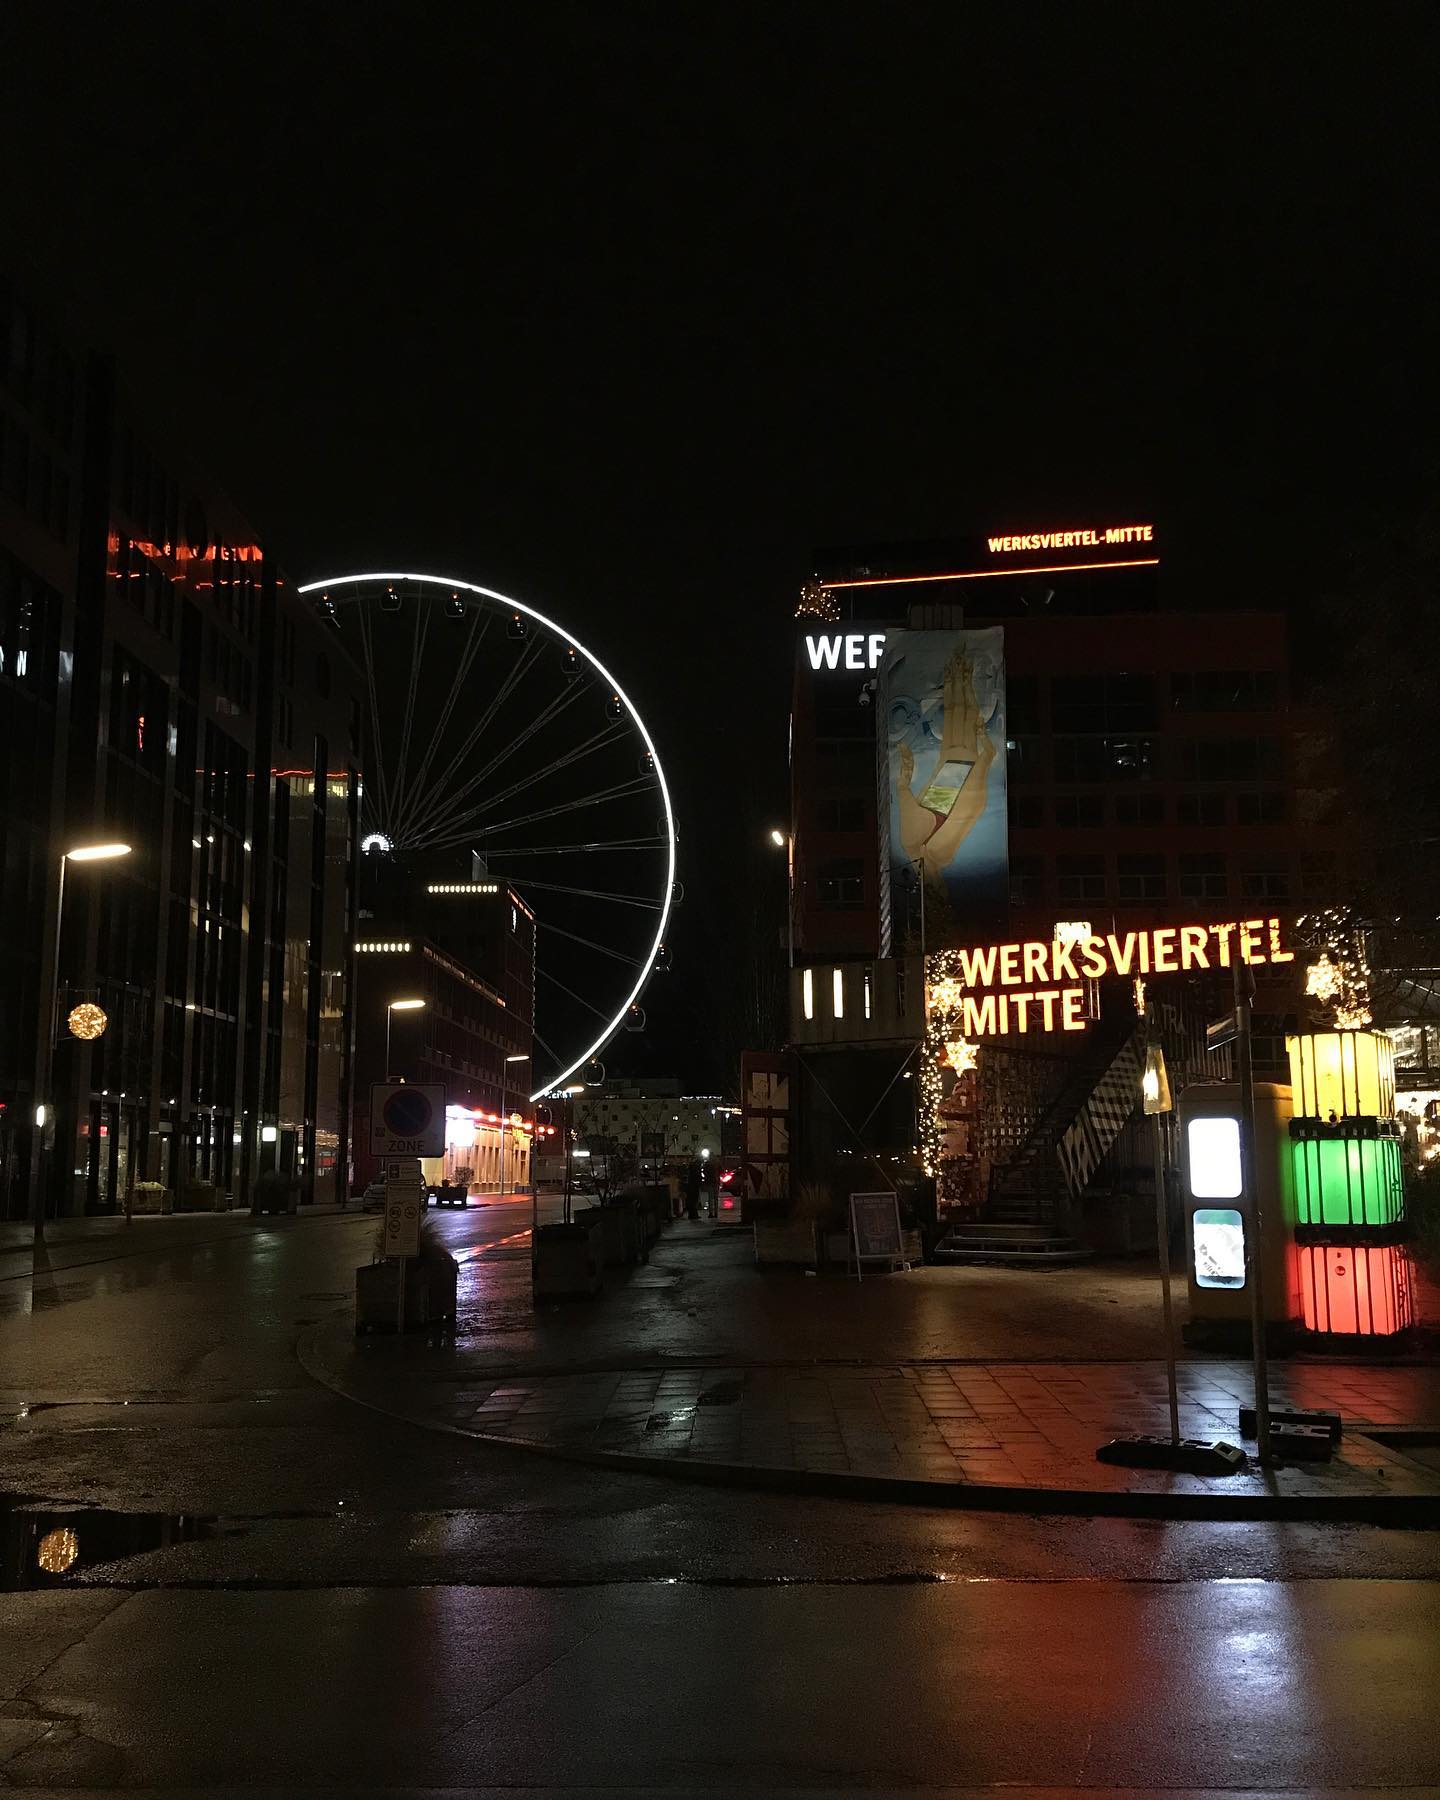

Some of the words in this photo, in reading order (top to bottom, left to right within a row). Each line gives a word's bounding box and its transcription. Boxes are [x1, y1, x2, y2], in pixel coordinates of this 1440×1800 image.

[988, 525, 1154, 553] WERKSVIERTEL-MITTE
[959, 918, 1294, 988] WERKSVIERTEL
[962, 988, 1086, 1037] MITTE
[388, 1140, 425, 1152] ZONE
